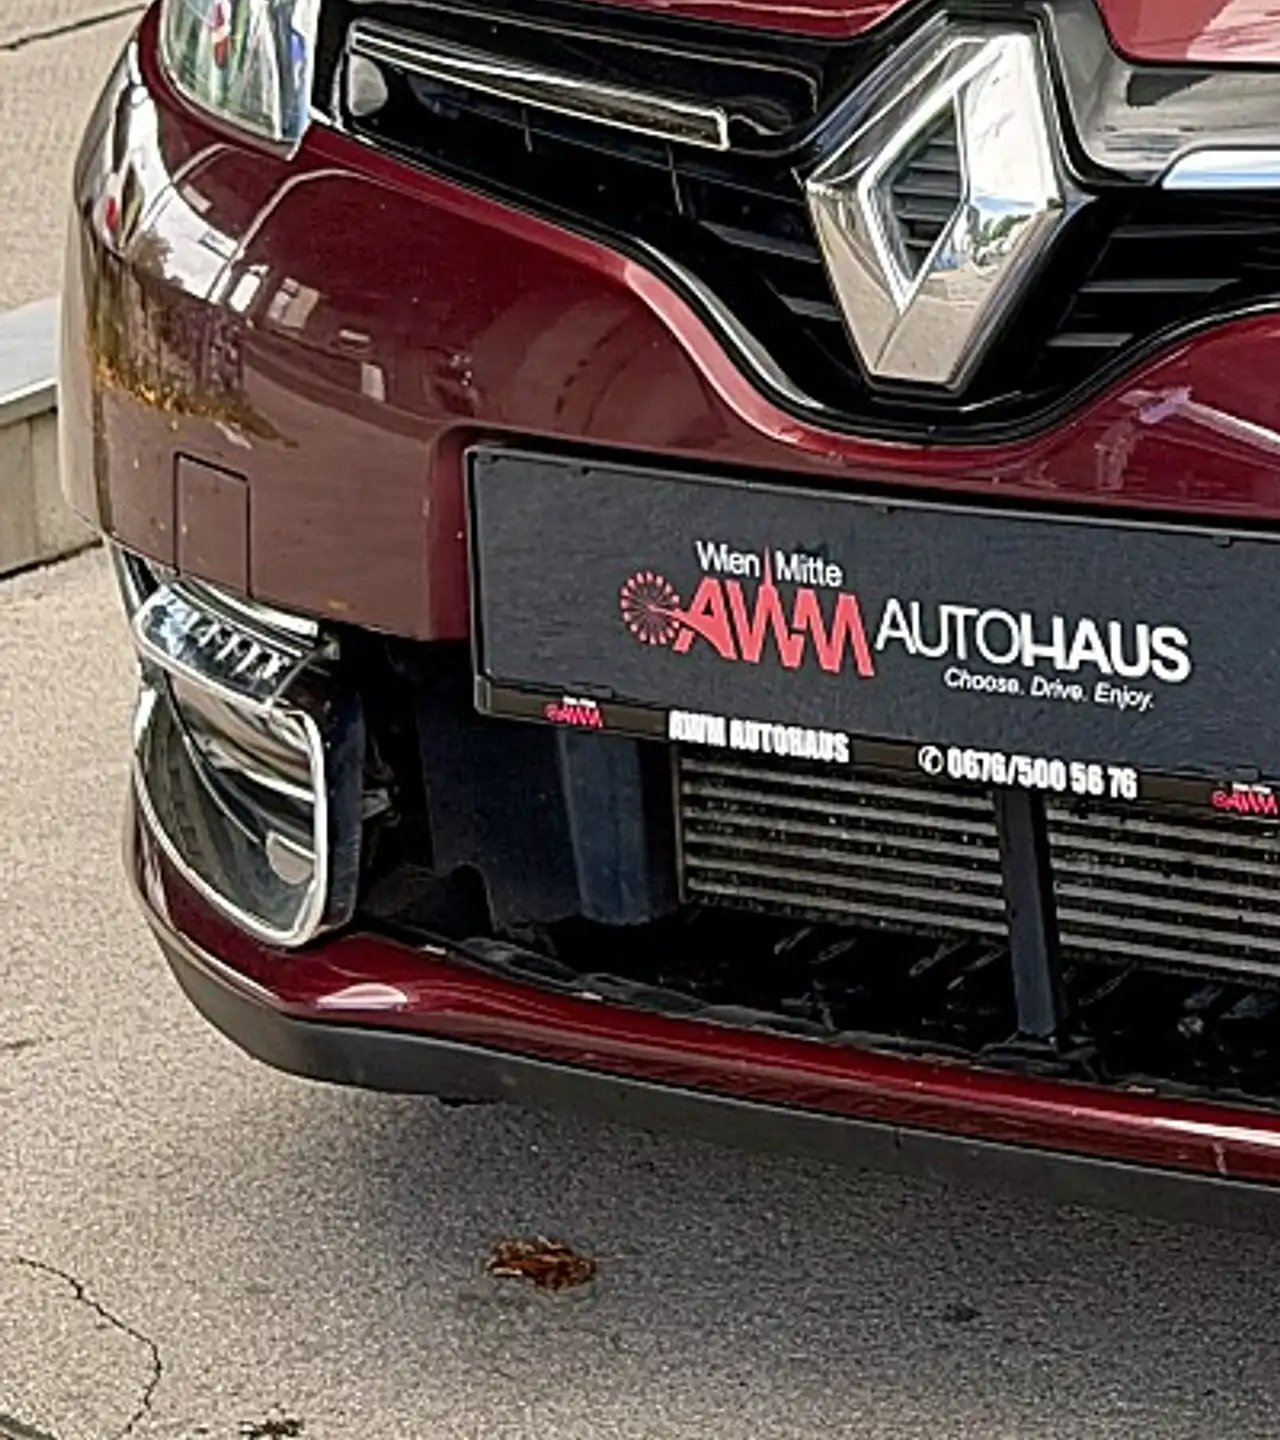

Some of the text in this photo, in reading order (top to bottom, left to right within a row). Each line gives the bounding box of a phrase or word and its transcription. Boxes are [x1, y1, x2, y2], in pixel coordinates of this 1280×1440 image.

[696, 541, 843, 587] Wien Mitte
[672, 575, 1191, 683] AWM AUTOHAUS
[944, 666, 1154, 712] Choose. Drive. Enjoy.
[668, 709, 849, 764] AWM AUTOHAUS
